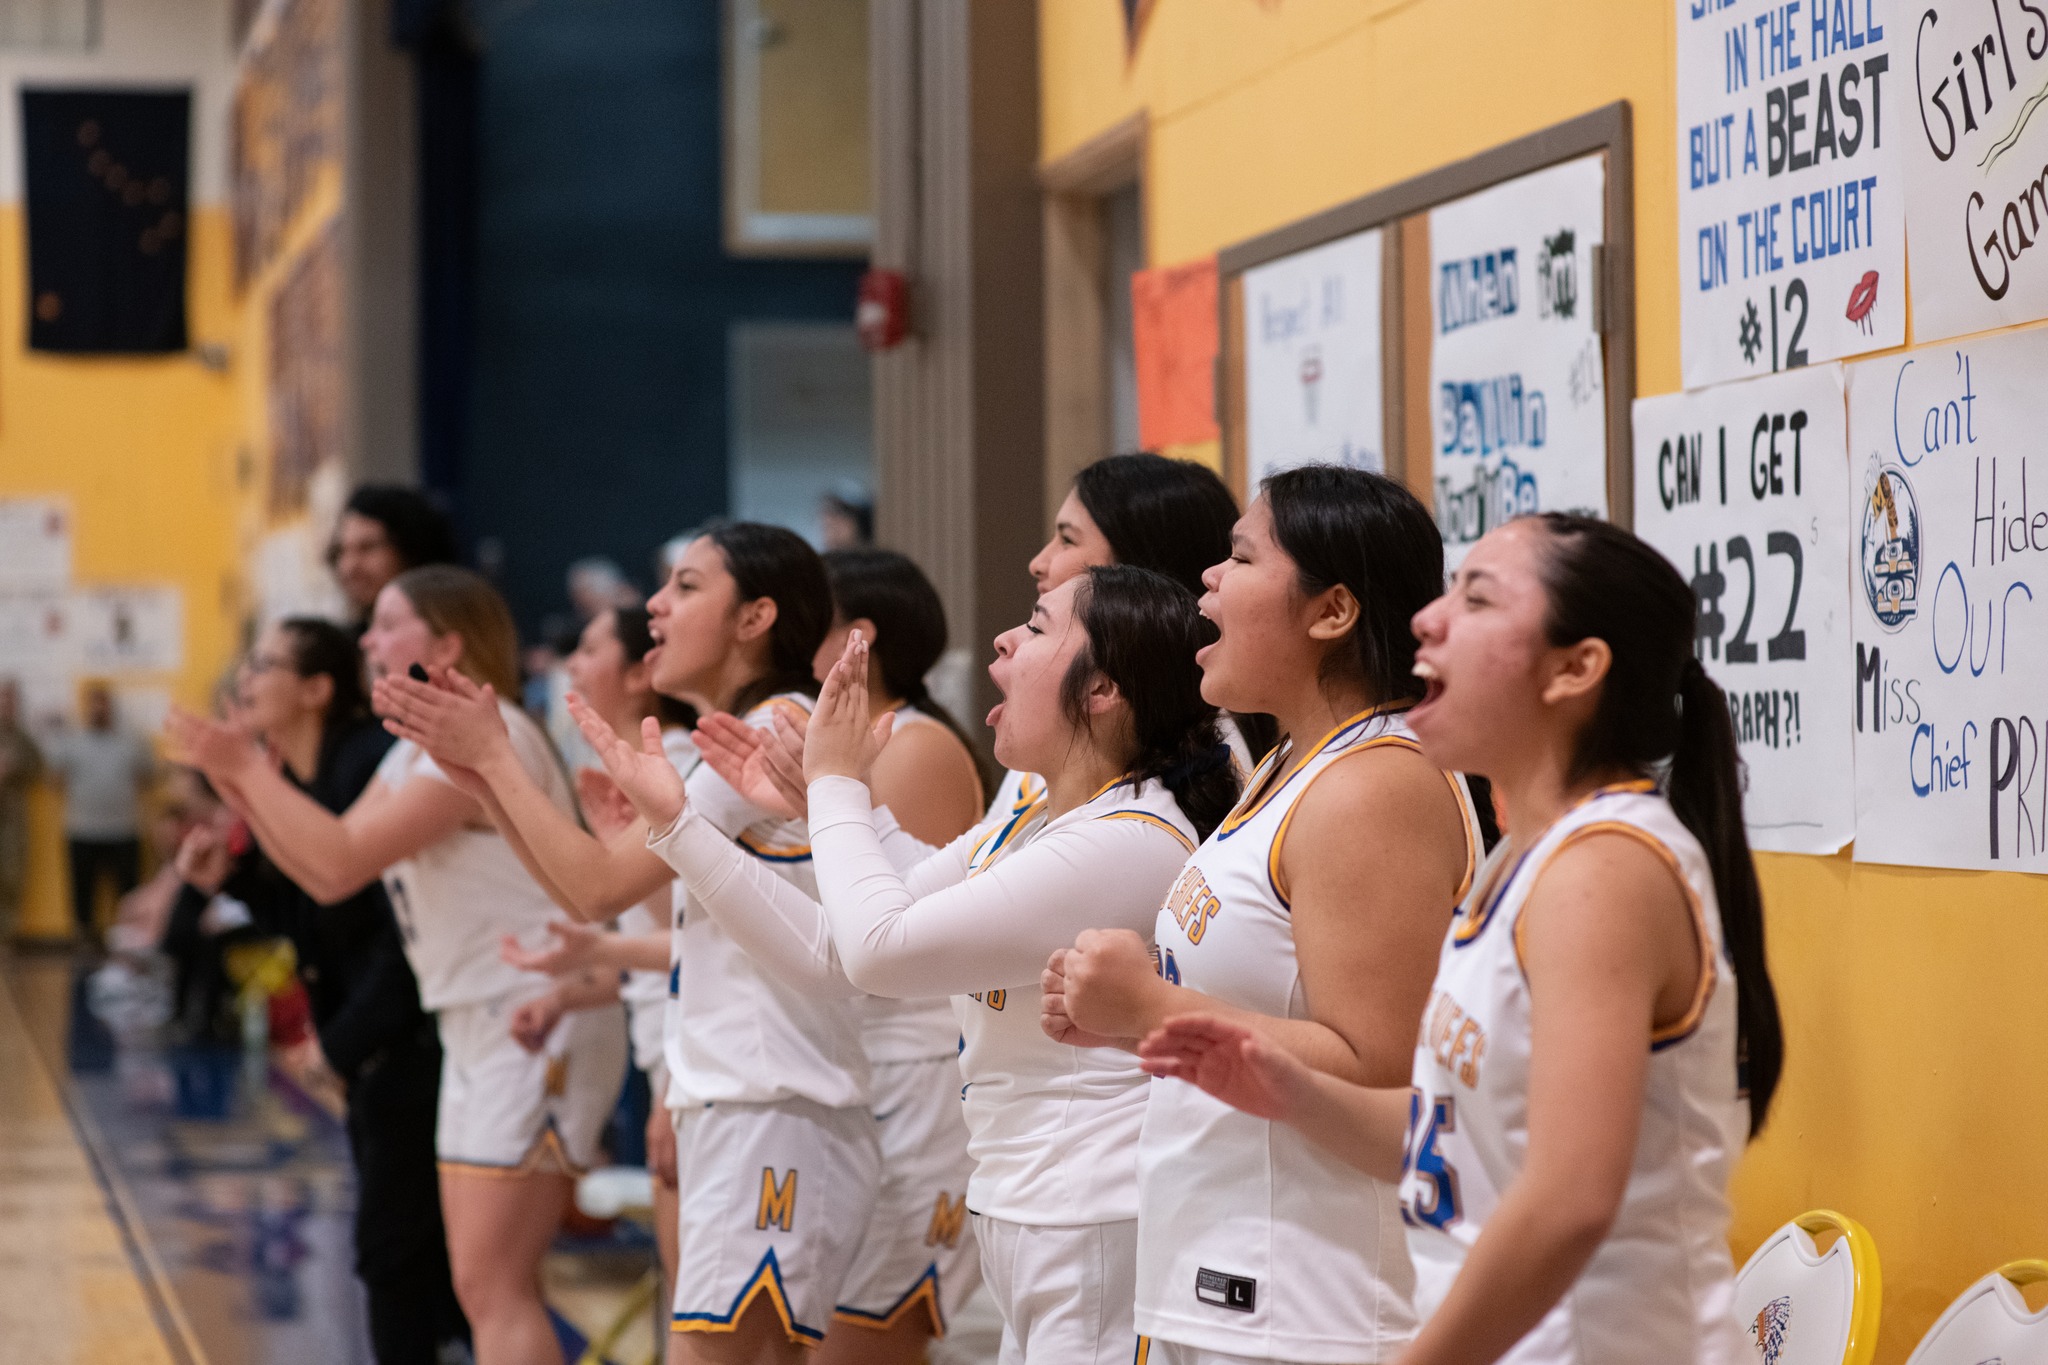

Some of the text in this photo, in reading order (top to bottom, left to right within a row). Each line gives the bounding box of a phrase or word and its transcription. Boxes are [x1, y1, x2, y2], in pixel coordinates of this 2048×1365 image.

[1725, 0, 1884, 94] IN THE HALL
[1690, 53, 1889, 190] BUT A BEAST
[1699, 175, 1877, 292] ON THE COURT
[1739, 277, 1809, 373] #12
[1893, 350, 1978, 467] Can't
[1658, 432, 1702, 512] CAN
[1718, 424, 1727, 506] I
[1750, 409, 1808, 501] GET
[1972, 456, 2048, 568] Hide
[1690, 529, 1806, 665] #22
[1932, 560, 2033, 678] Our
[1728, 689, 1801, 749] RAPH?!
[1856, 641, 1921, 734] Miss
[1910, 720, 1978, 798] Chief
[756, 1166, 798, 1233] M
[925, 1190, 967, 1250] M
[1235, 1286, 1244, 1302] L
